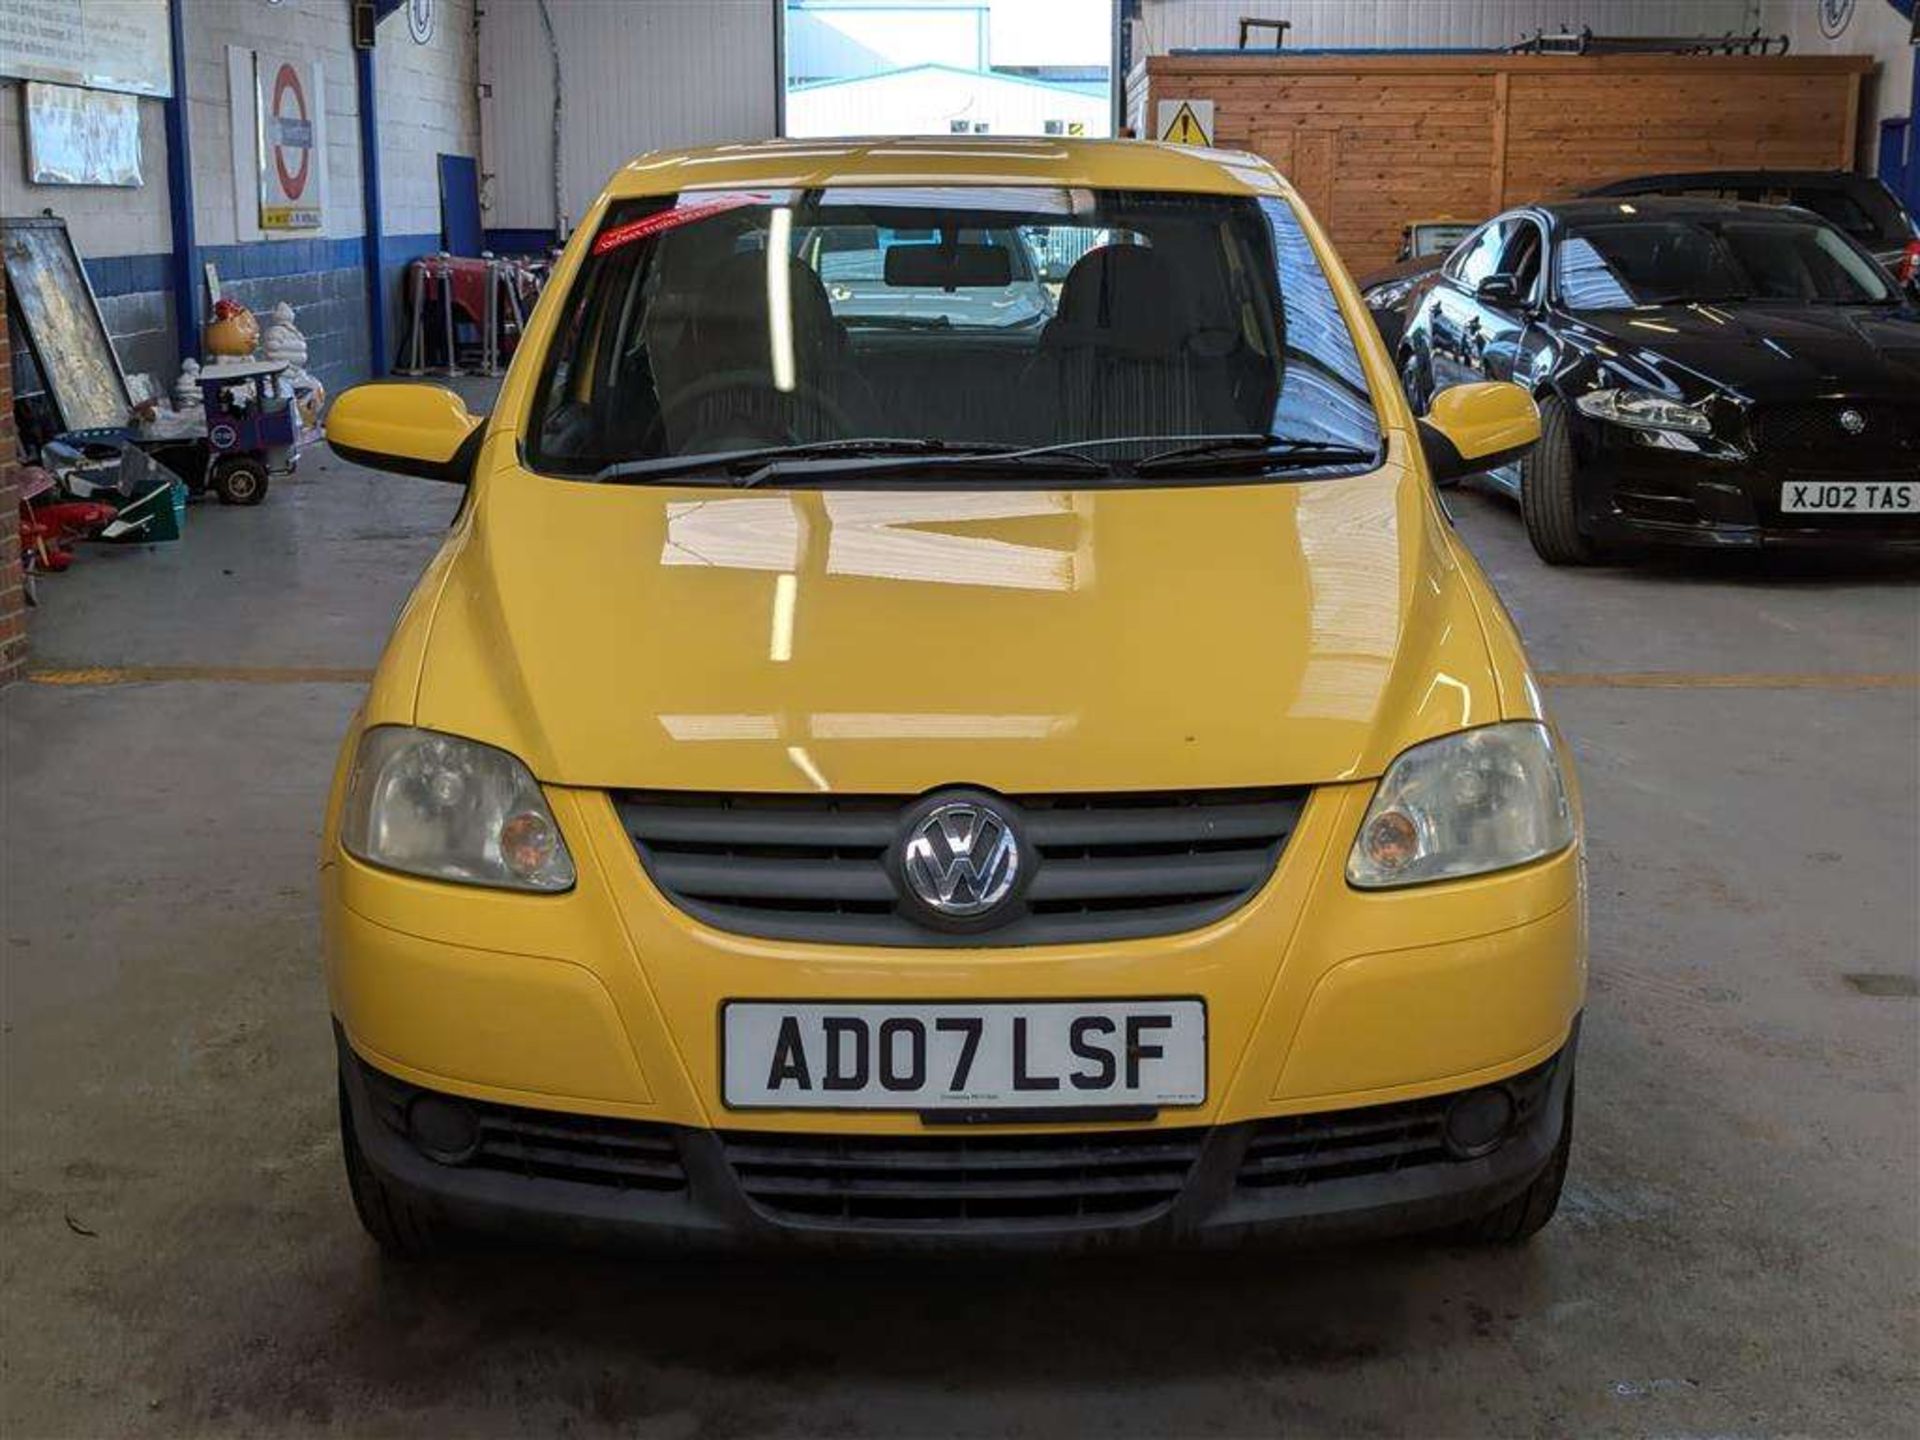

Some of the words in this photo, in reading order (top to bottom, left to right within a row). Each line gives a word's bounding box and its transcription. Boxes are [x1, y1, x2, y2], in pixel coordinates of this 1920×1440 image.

[1792, 486, 1857, 508] XJ02
[1865, 486, 1911, 508] TAS
[766, 1016, 983, 1092] AD07
[1012, 1015, 1173, 1091] LSF
